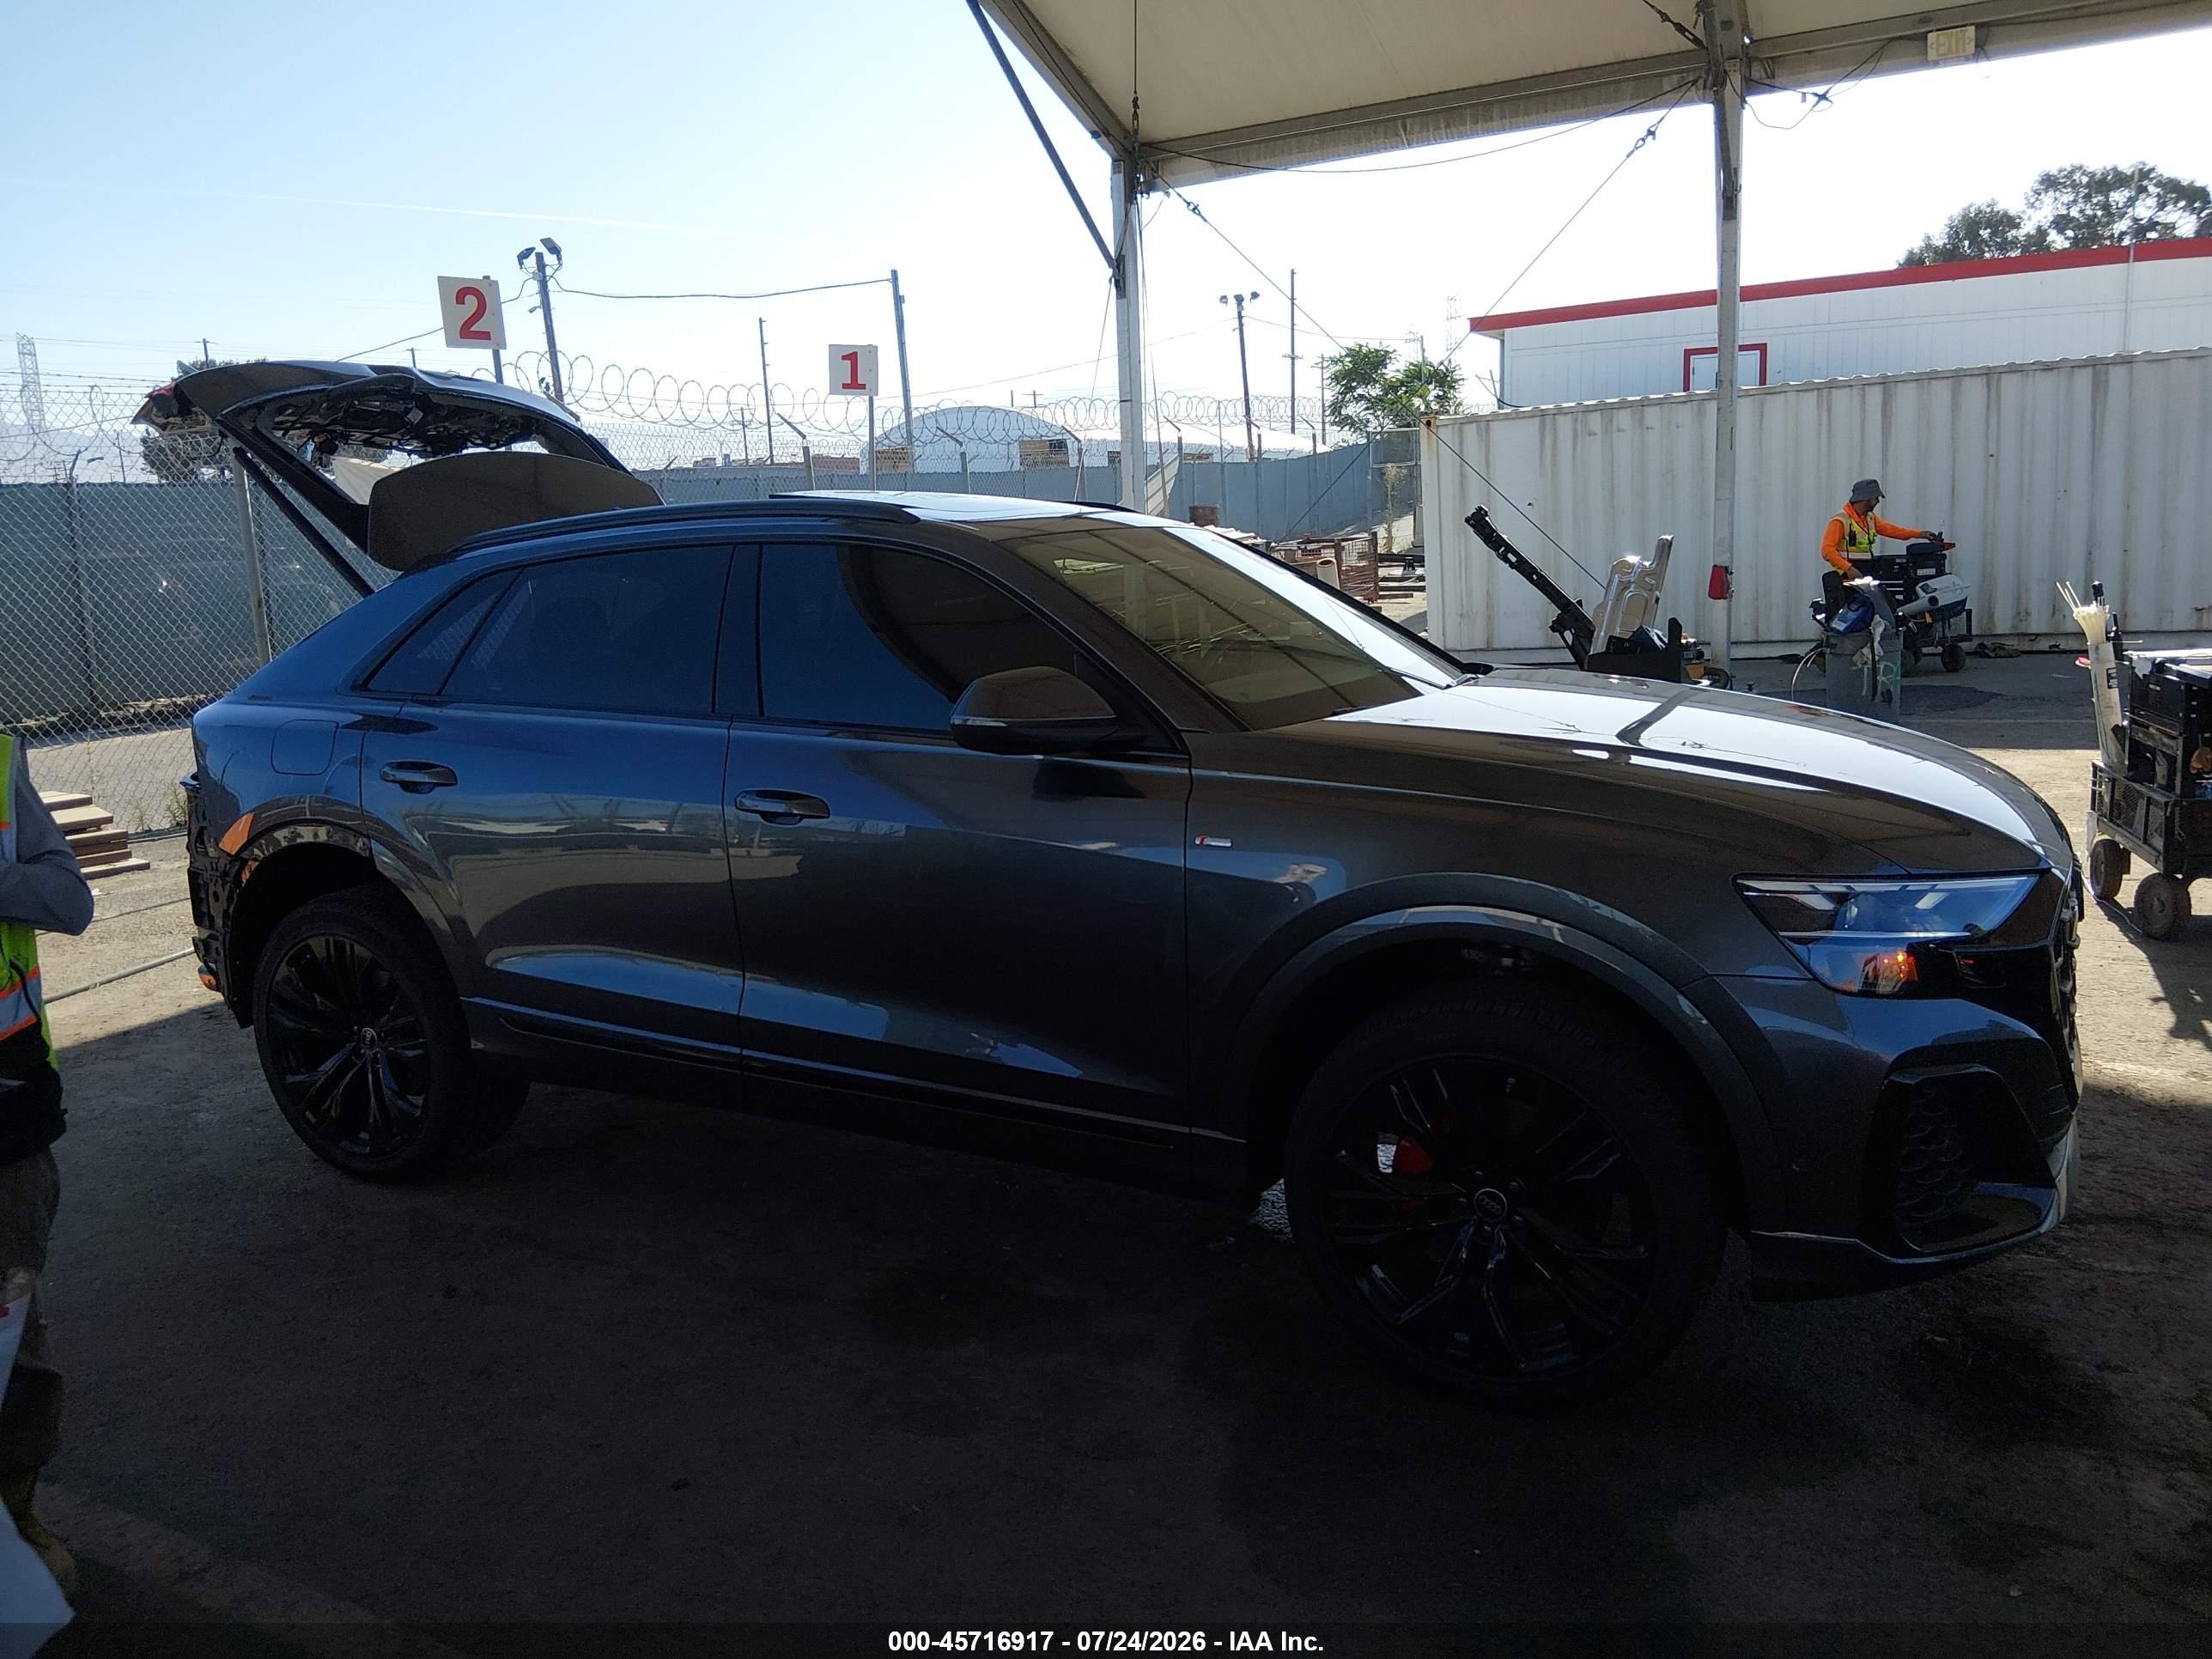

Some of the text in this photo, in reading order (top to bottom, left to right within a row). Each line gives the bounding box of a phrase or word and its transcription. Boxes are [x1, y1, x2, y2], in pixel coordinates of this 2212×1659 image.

[1936, 29, 1966, 57] EXIT
[455, 286, 490, 341] 2
[842, 351, 866, 390] 1
